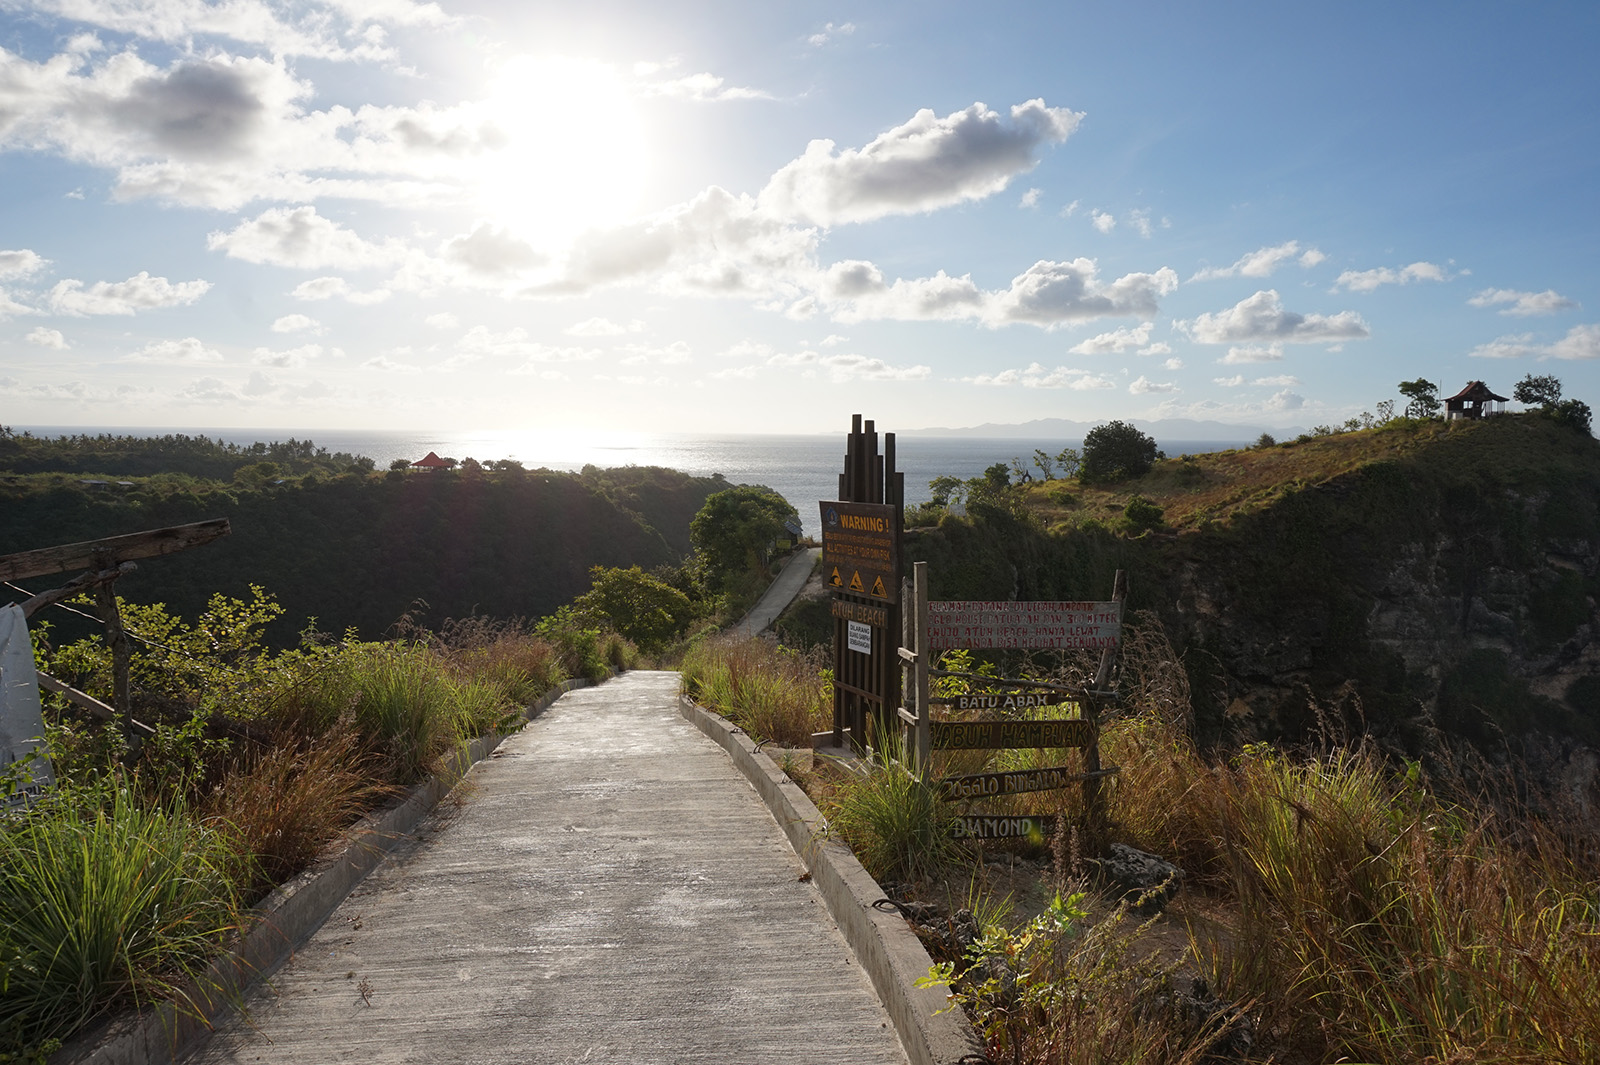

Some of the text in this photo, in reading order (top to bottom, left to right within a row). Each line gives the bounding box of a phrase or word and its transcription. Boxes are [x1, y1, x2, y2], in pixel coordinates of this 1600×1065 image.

[840, 515, 884, 533] WARNING
[832, 601, 885, 626] ATUH BEACH
[928, 627, 959, 637] ENUJU
[1070, 626, 1101, 637] LEWAT
[959, 695, 1048, 709] BATU ABAH
[1001, 723, 1088, 748] HAMPUAK
[953, 818, 1032, 838] DIAMOND
